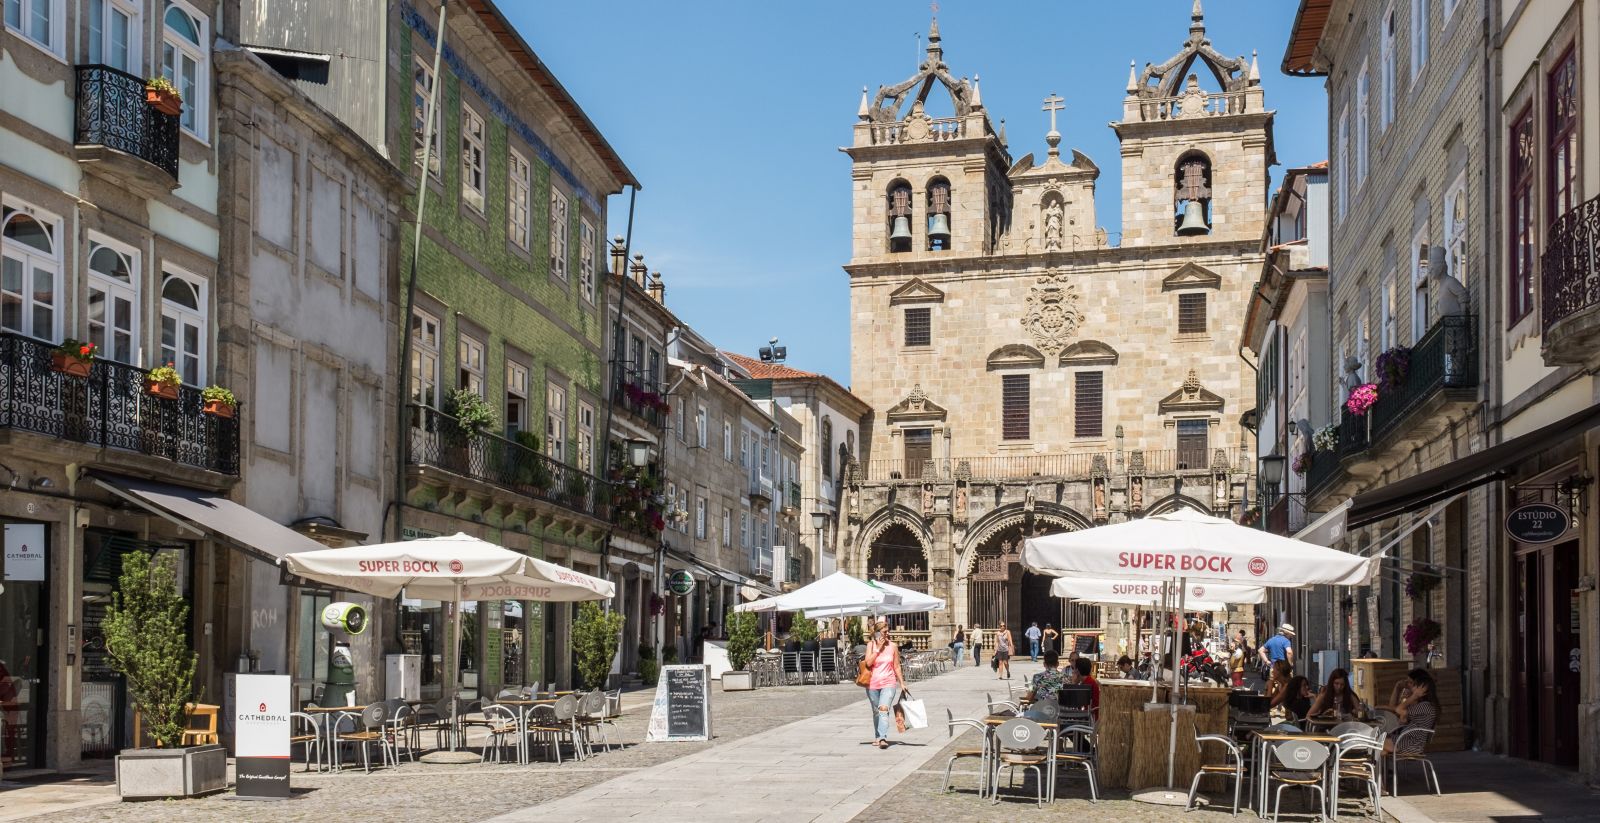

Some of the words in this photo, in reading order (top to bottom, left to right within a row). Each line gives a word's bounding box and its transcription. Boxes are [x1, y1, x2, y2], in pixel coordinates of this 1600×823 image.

[1518, 510, 1557, 520] ESTÚDIO
[1532, 520, 1543, 529] 22
[359, 560, 399, 572] SUPER
[403, 560, 440, 573] BOCK
[1118, 552, 1175, 570] SUPER
[1180, 554, 1233, 573] BOCK
[1112, 584, 1148, 595] SUPER
